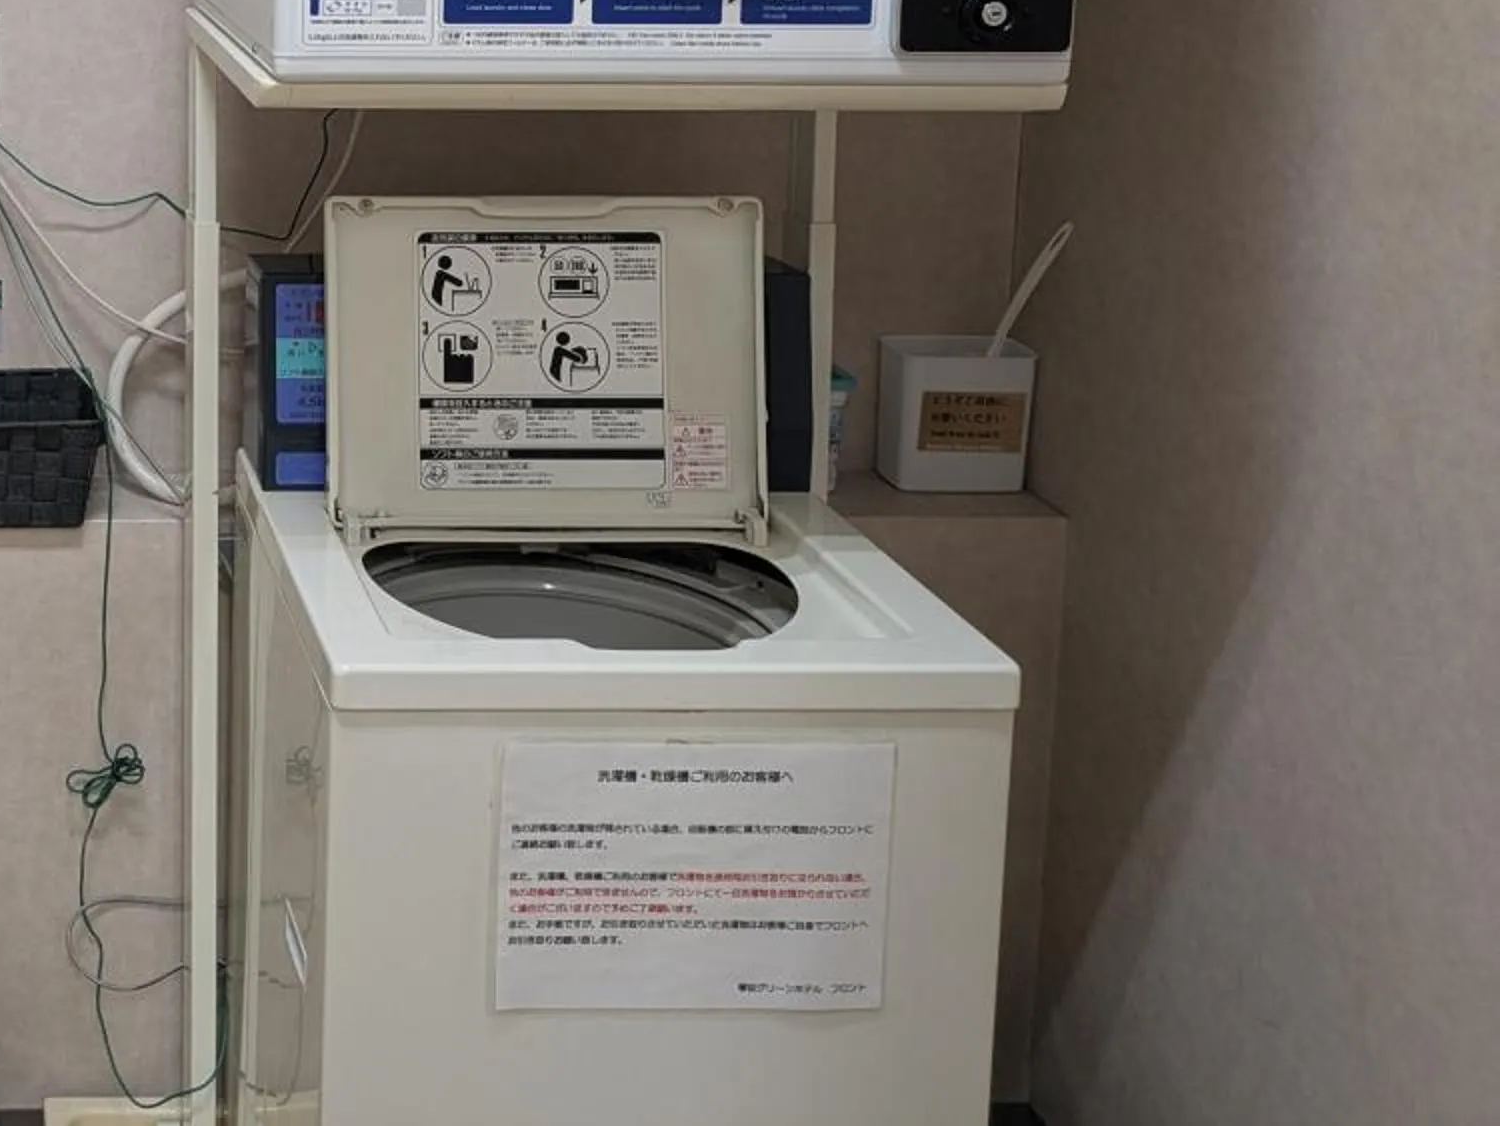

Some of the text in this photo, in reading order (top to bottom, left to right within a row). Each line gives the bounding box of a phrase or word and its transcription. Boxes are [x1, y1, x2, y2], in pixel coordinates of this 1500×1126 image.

[597, 768, 794, 785] 洗濯機・乾燥機ご利用のお客様へ
